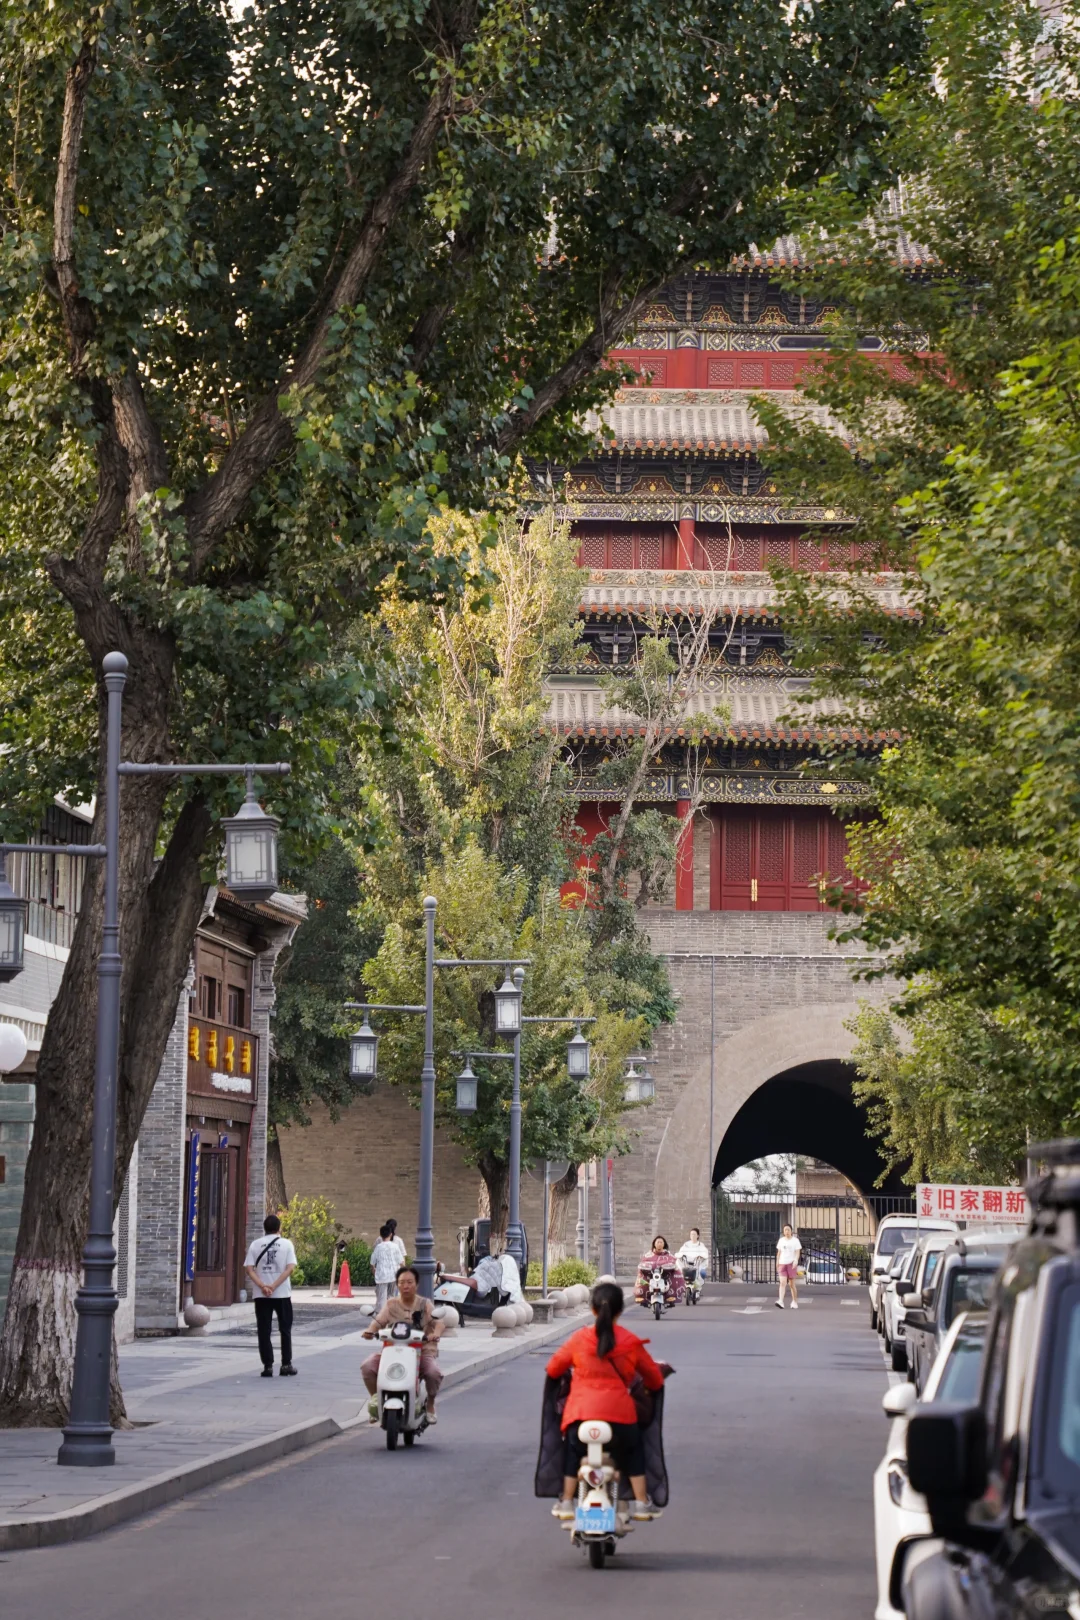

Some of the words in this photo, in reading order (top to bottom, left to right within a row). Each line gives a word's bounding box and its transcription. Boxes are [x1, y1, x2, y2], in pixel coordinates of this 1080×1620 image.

[921, 1187, 933, 1216] 专业
[938, 1189, 1026, 1214] 旧家翻新
